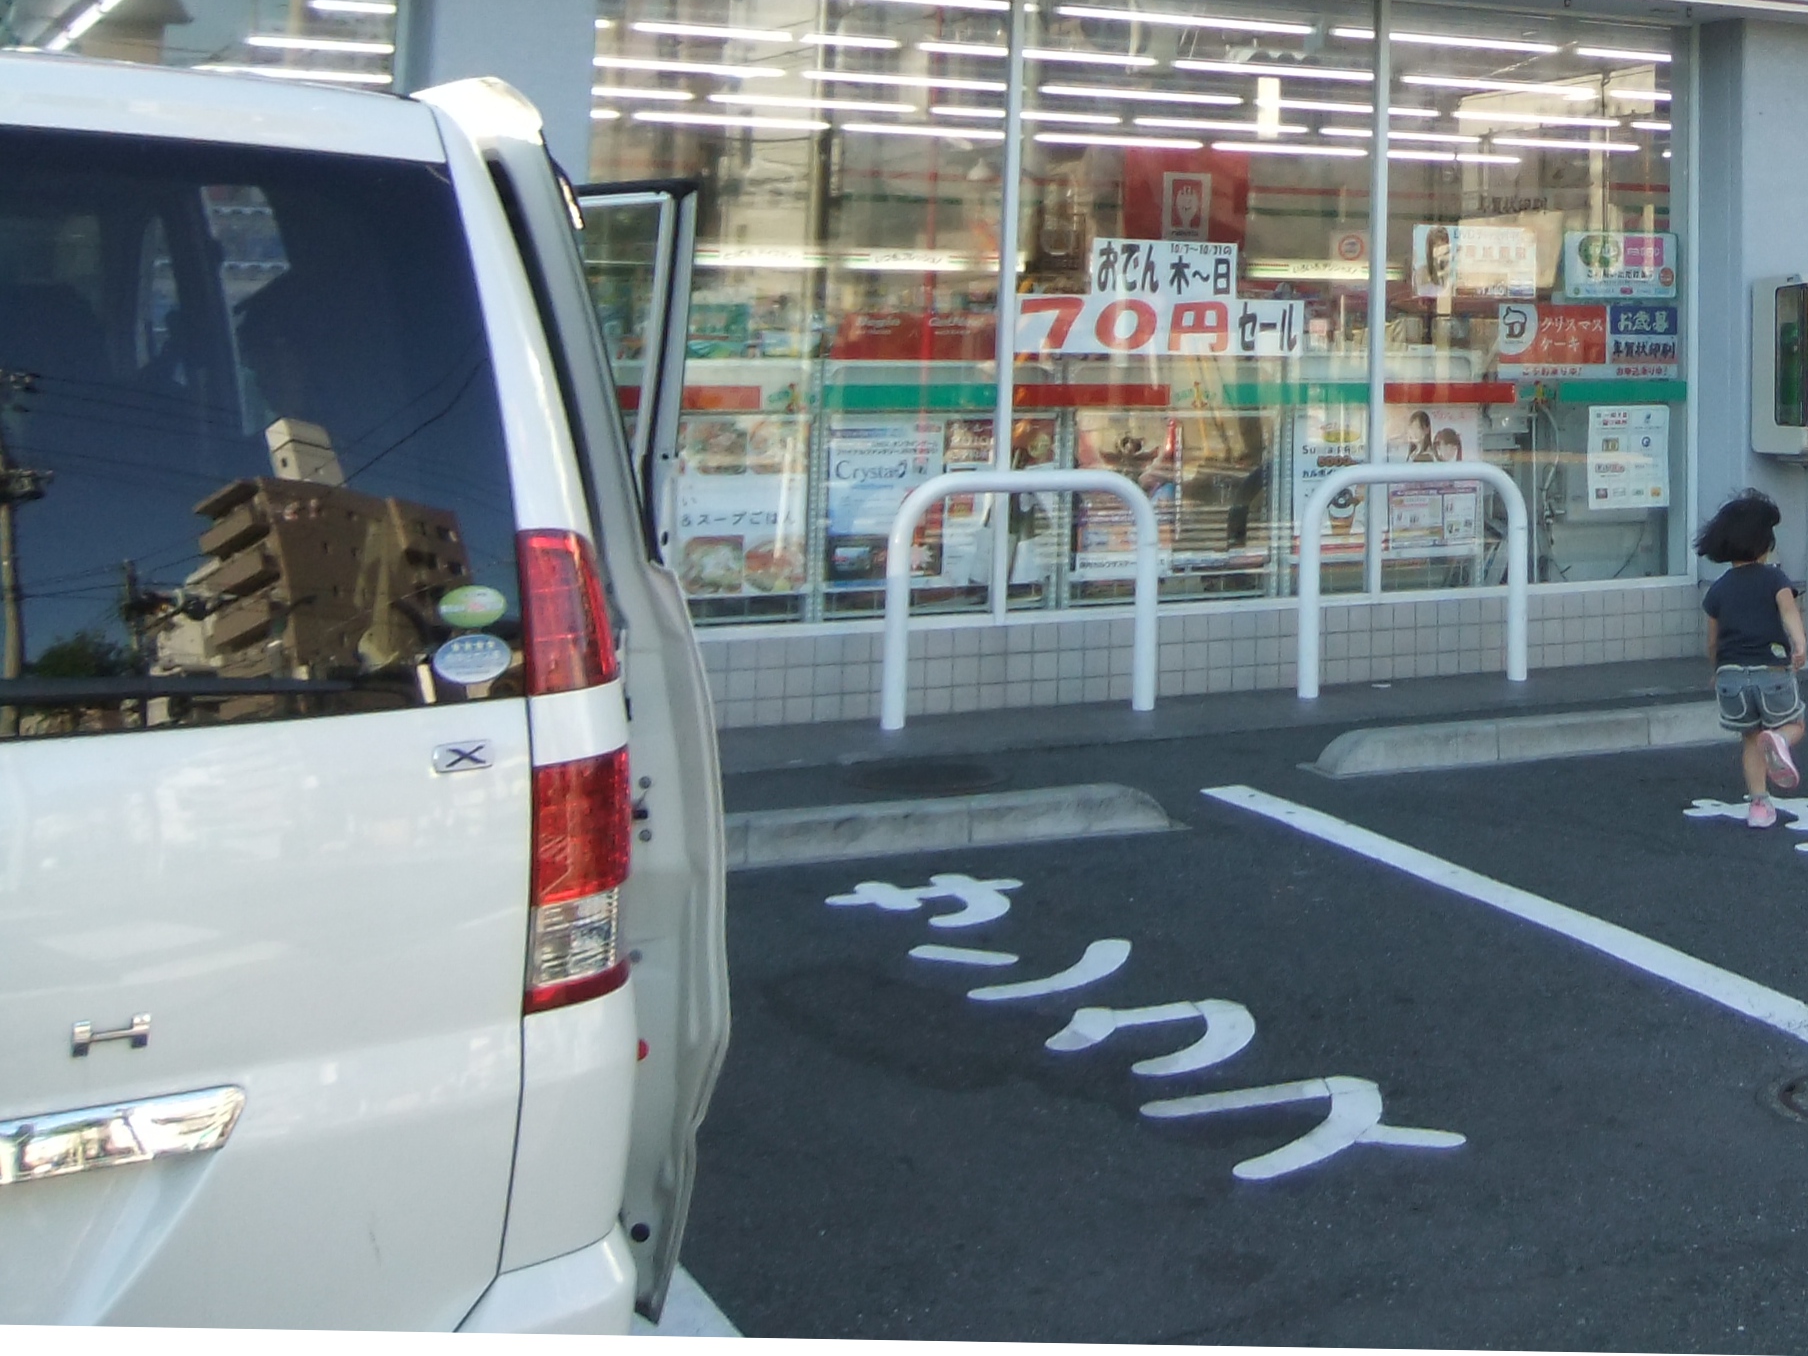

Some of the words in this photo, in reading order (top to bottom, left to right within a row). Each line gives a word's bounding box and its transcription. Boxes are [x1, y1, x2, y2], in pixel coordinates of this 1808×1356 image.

[1097, 240, 1160, 293] おでん
[1019, 296, 1230, 353] 70円
[1238, 300, 1298, 352] セール
[1541, 315, 1604, 333] クリスマス
[1617, 310, 1670, 333] お歳暮
[1541, 335, 1580, 353] ケーキ
[1612, 338, 1676, 359] 年賀状印刷
[824, 873, 1467, 1181] サンクス
